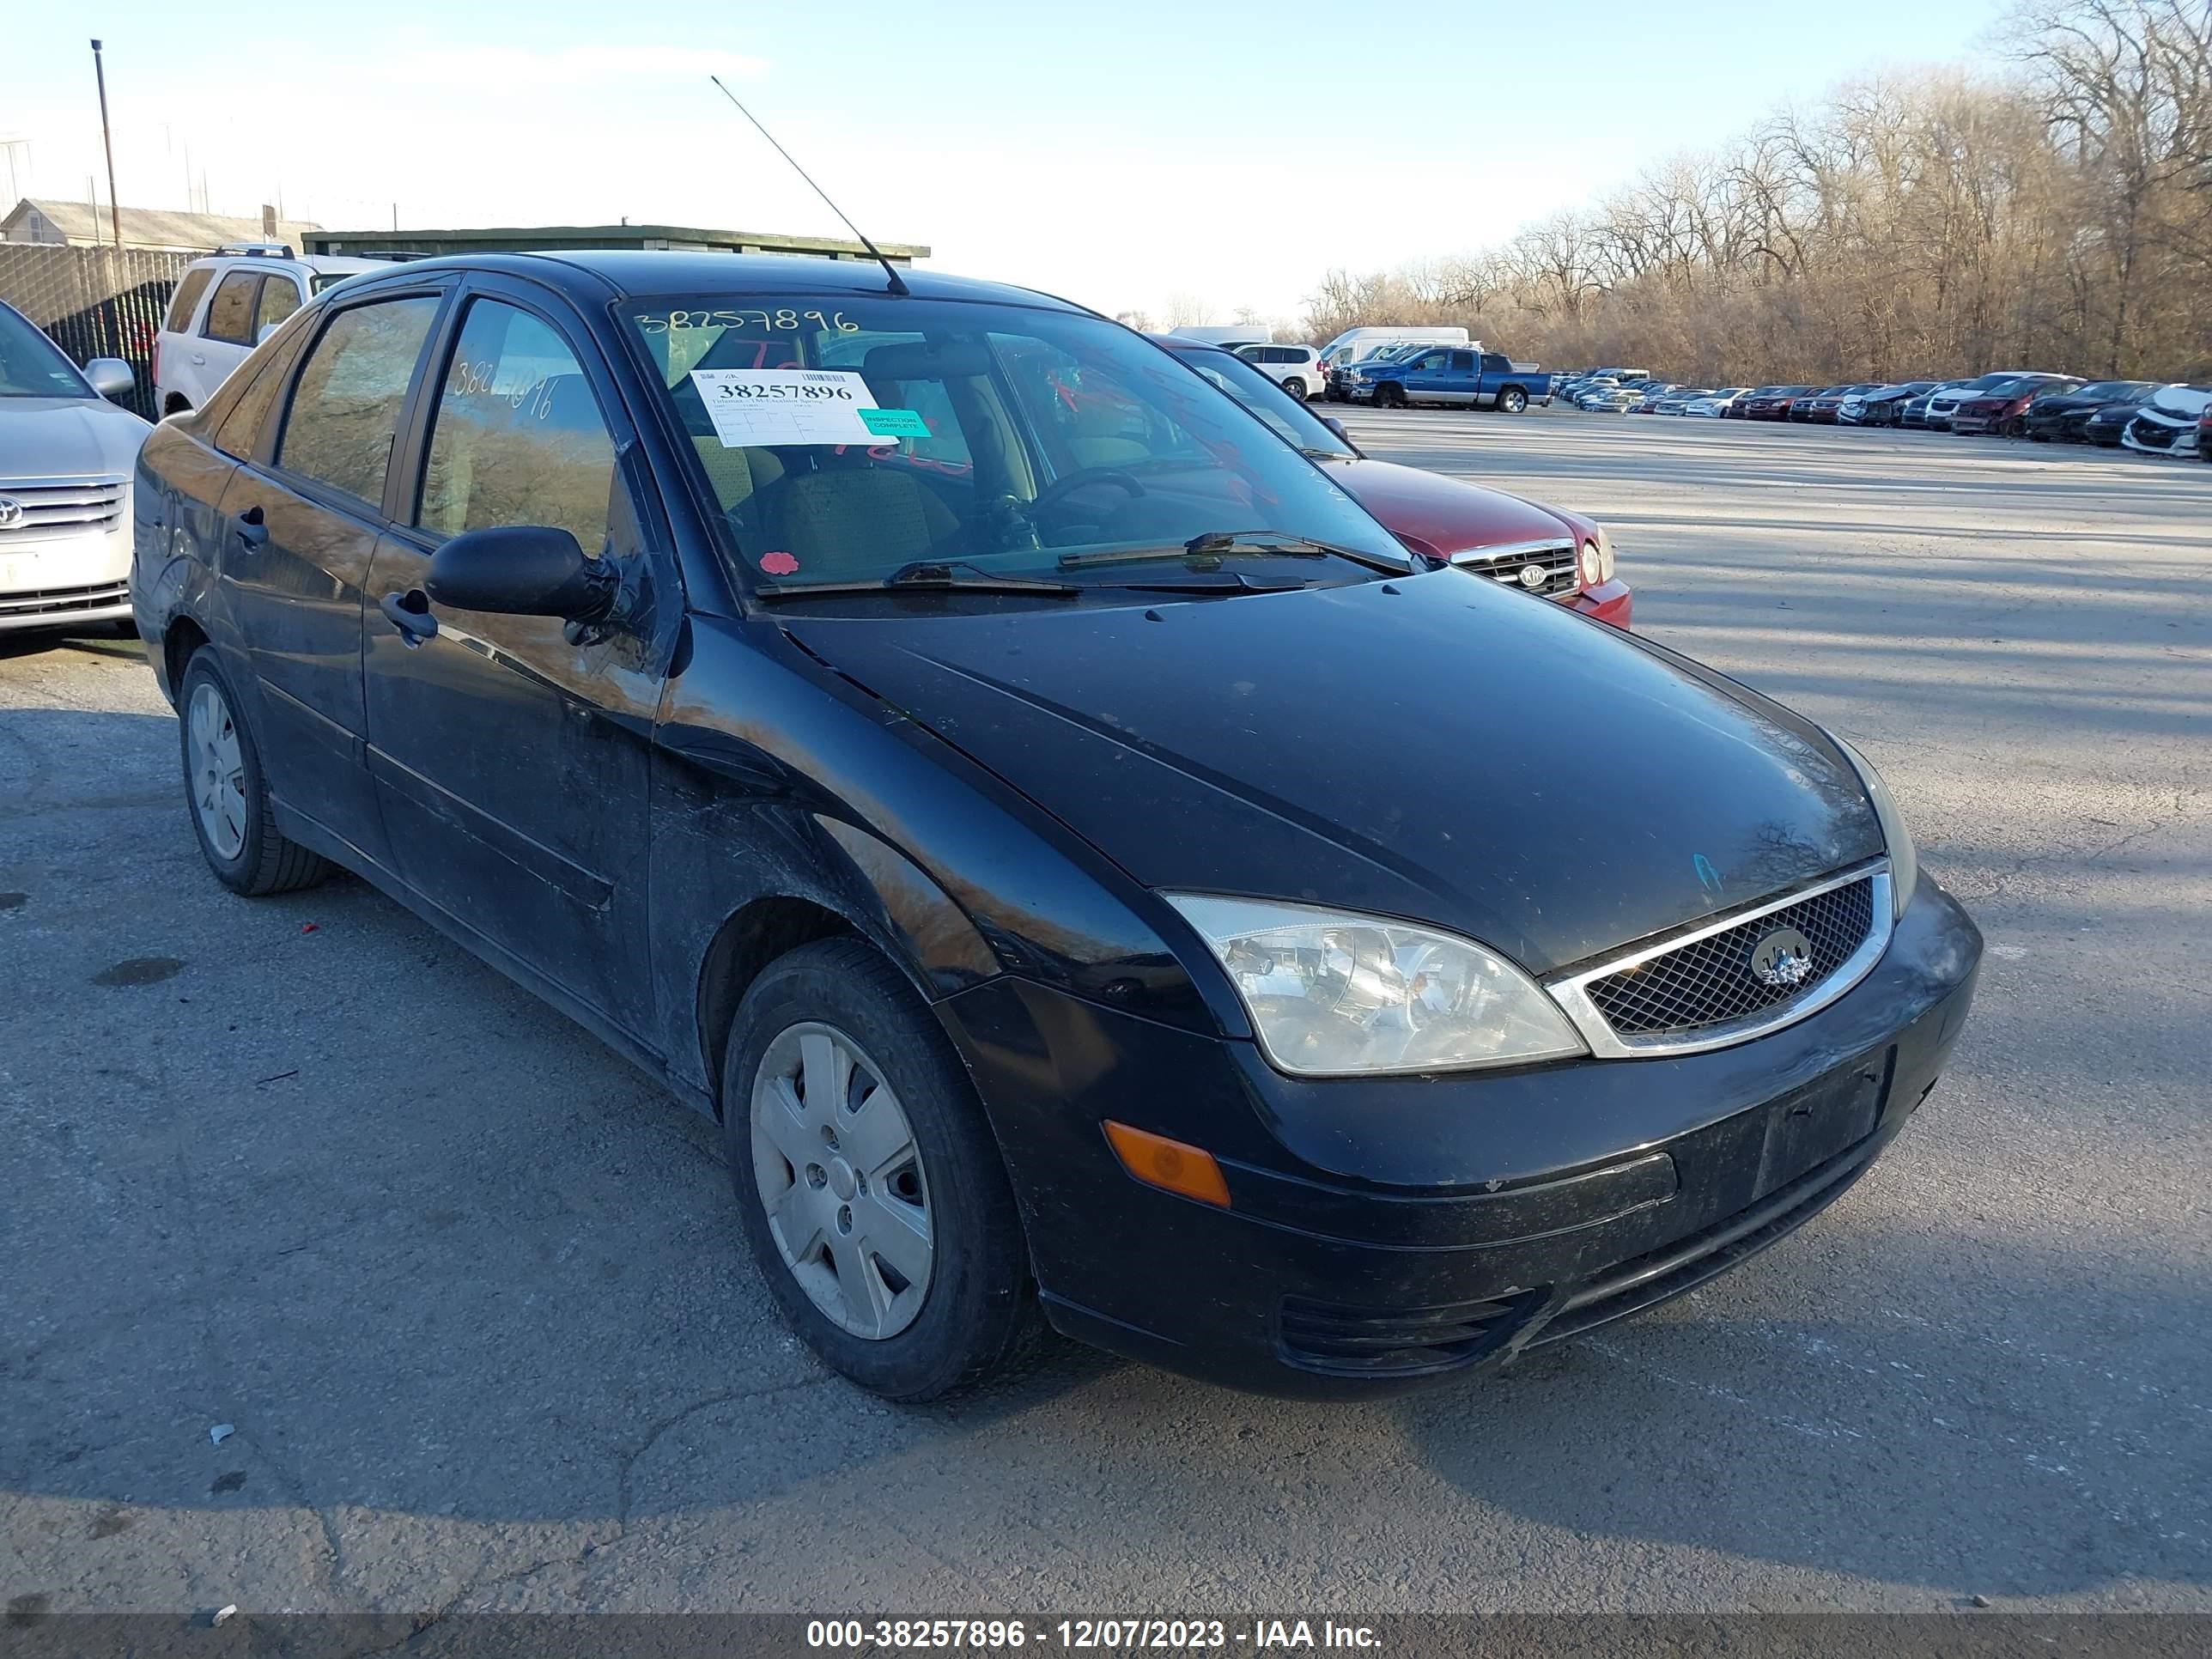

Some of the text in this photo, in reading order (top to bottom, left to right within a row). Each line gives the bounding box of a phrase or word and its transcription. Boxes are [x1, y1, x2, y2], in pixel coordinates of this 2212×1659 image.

[634, 309, 860, 334] 38257896
[716, 384, 853, 400] 38257896
[866, 416, 918, 424] INSPECTION
